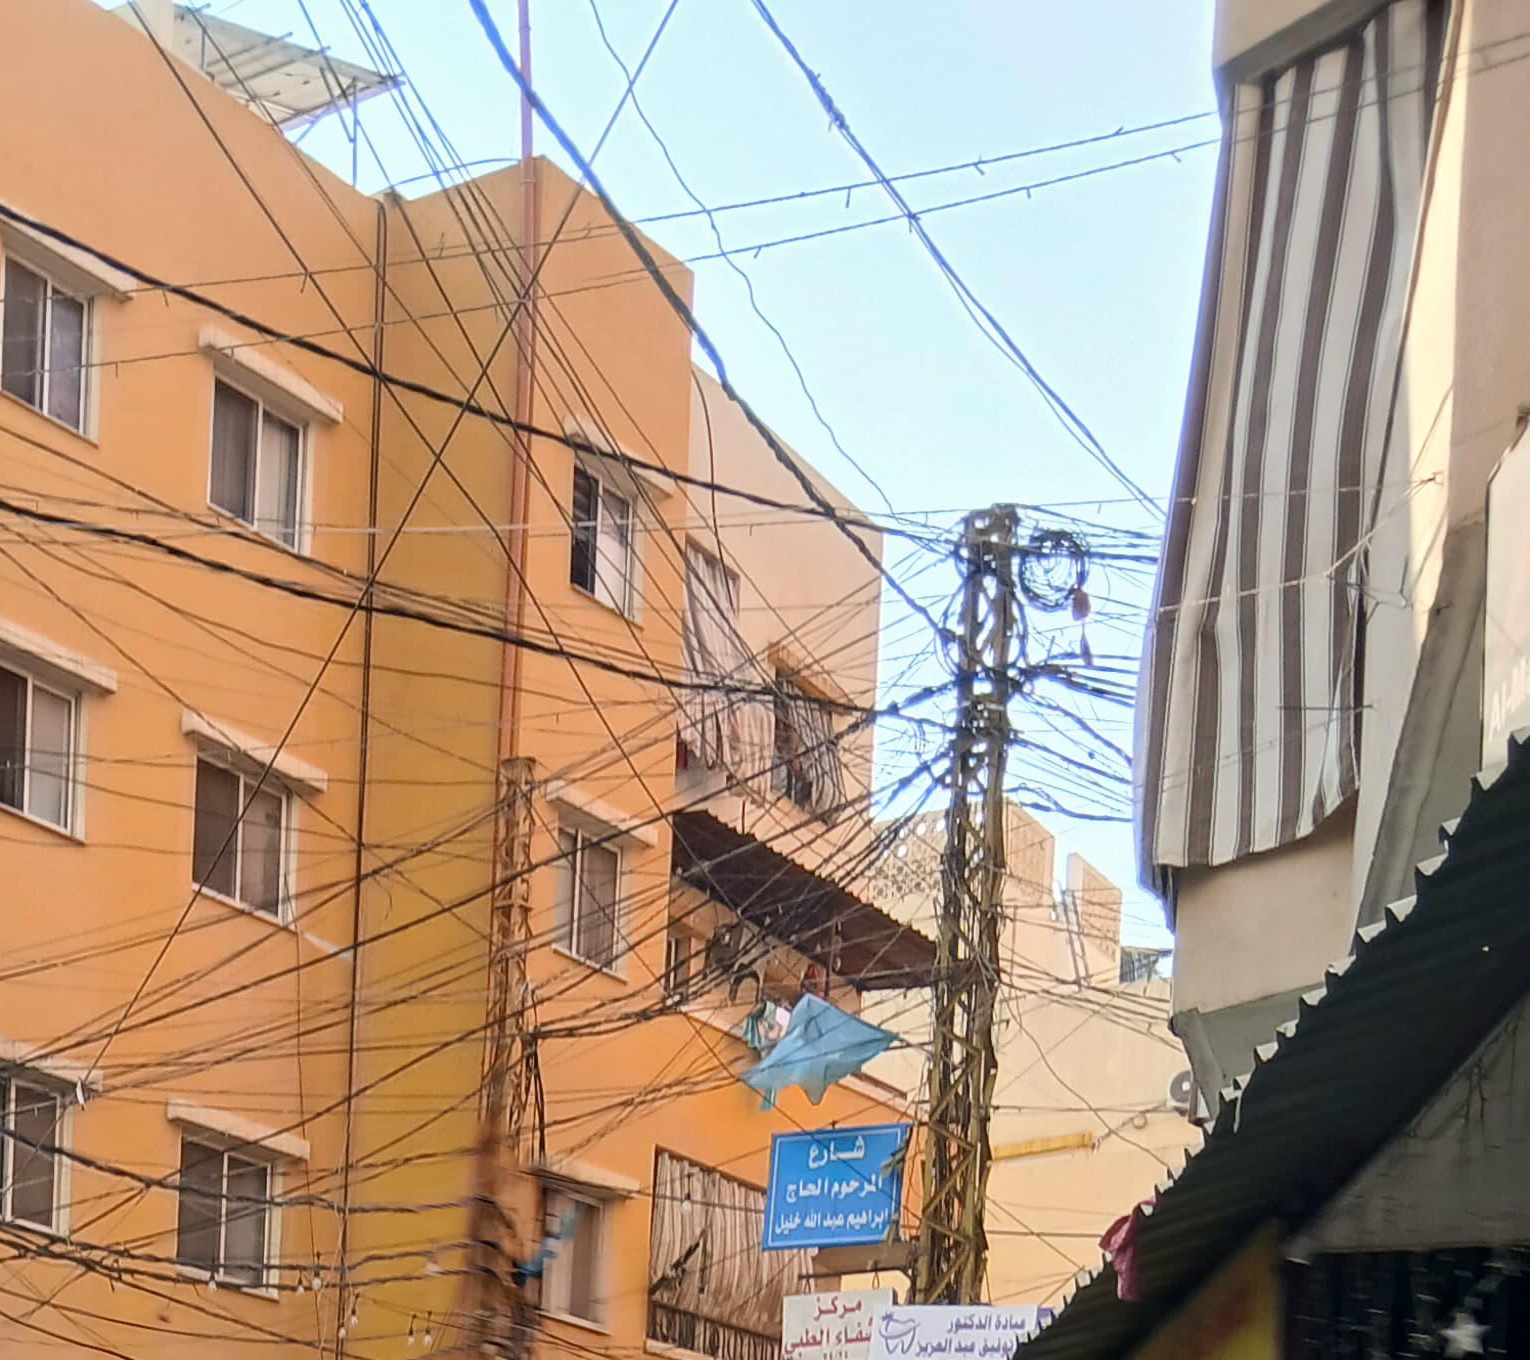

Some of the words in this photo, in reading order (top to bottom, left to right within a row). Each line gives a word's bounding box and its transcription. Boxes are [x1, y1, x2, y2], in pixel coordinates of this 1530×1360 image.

[808, 1135, 865, 1169] شارع
[786, 1178, 829, 1203] الحاج
[831, 1173, 882, 1199] المرحوم
[804, 1209, 821, 1228] الله
[823, 1212, 844, 1230] عبد
[813, 1296, 862, 1321] مركز
[947, 1313, 992, 1335] الدكتور
[785, 1328, 830, 1356] الطبي
[955, 1340, 975, 1358] عبد
